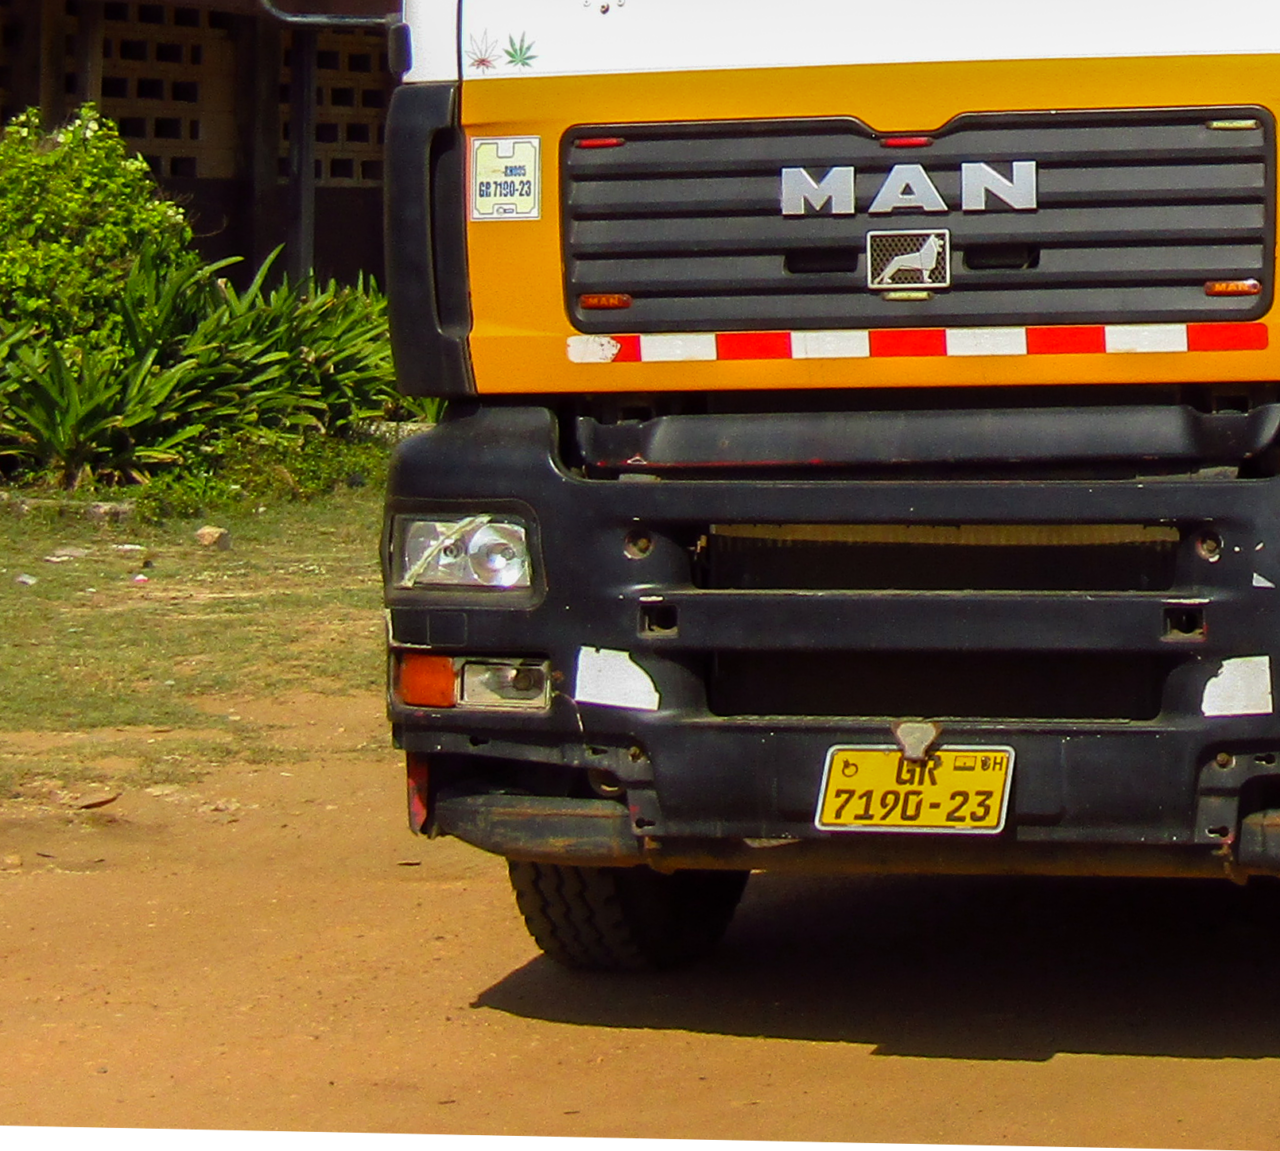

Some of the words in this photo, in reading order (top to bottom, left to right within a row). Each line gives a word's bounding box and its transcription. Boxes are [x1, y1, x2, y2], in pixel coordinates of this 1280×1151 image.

[493, 180, 532, 197] 7190-23
[780, 161, 1038, 215] MAN
[1214, 283, 1249, 291] MAN
[588, 297, 619, 305] MAN
[896, 756, 938, 786] GR
[834, 789, 994, 822] 7190-23
